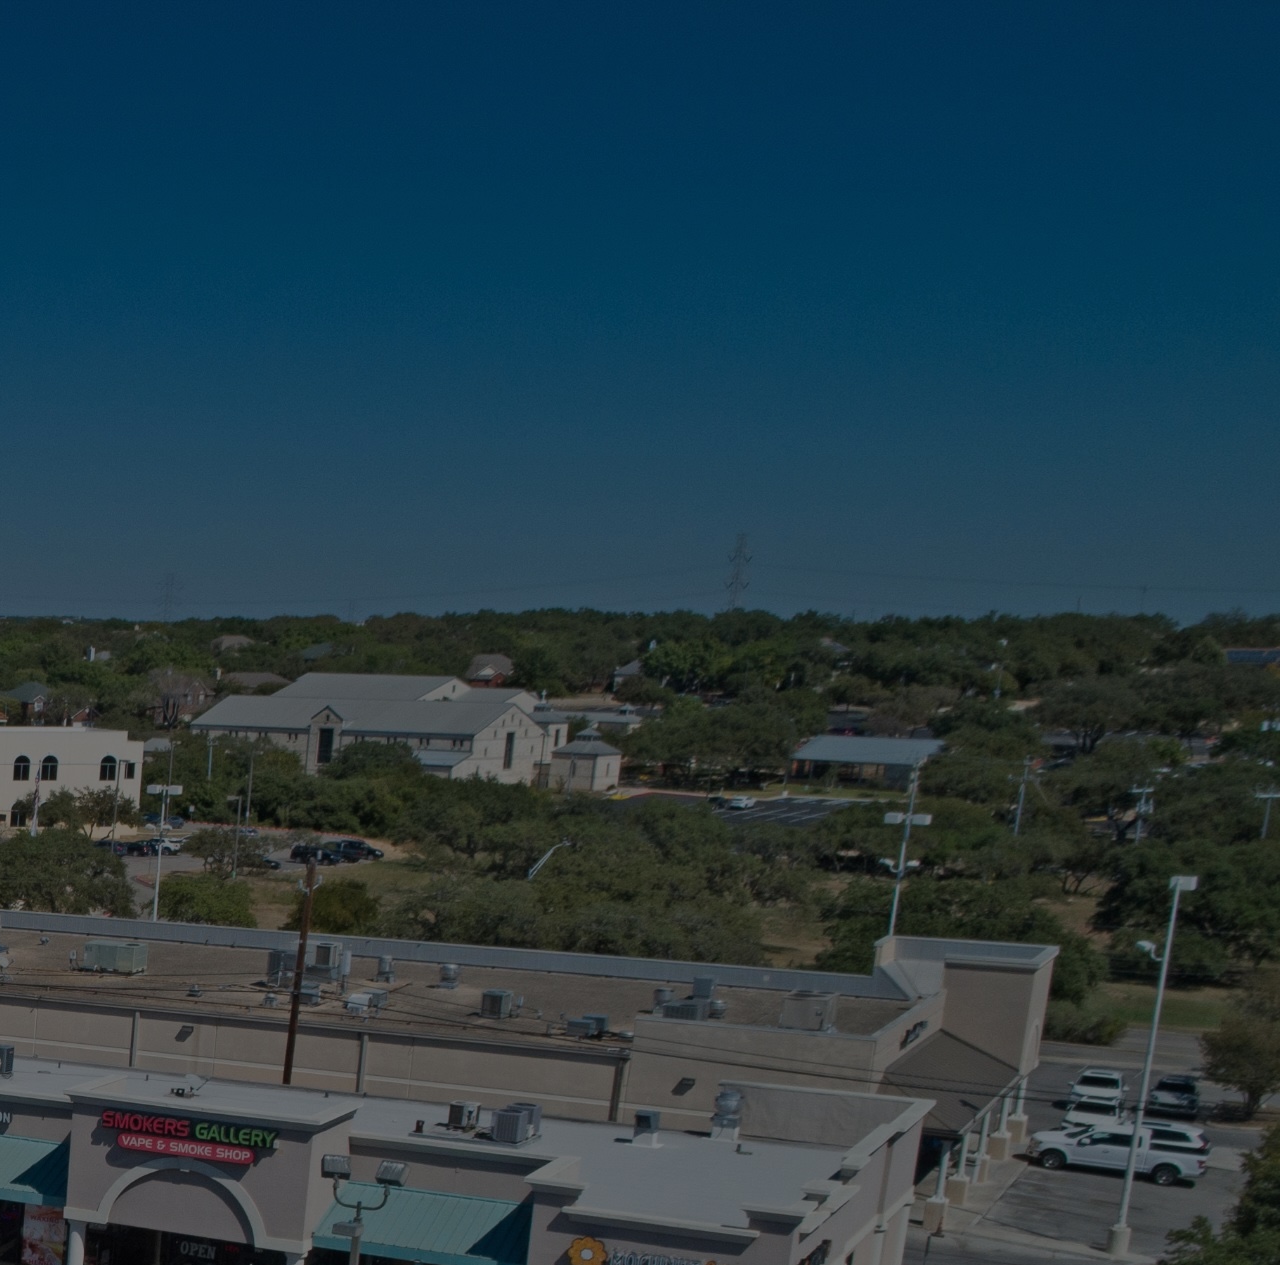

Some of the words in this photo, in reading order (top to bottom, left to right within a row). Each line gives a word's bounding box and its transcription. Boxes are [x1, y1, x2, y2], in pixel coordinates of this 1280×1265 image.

[102, 1110, 190, 1137] SMOKERS
[195, 1122, 277, 1148] GALLERY
[122, 1136, 153, 1149] VAPE
[157, 1139, 166, 1150] &
[170, 1142, 212, 1157] SMOKE
[216, 1148, 251, 1161] SHOP
[180, 1240, 217, 1260] OPEN
